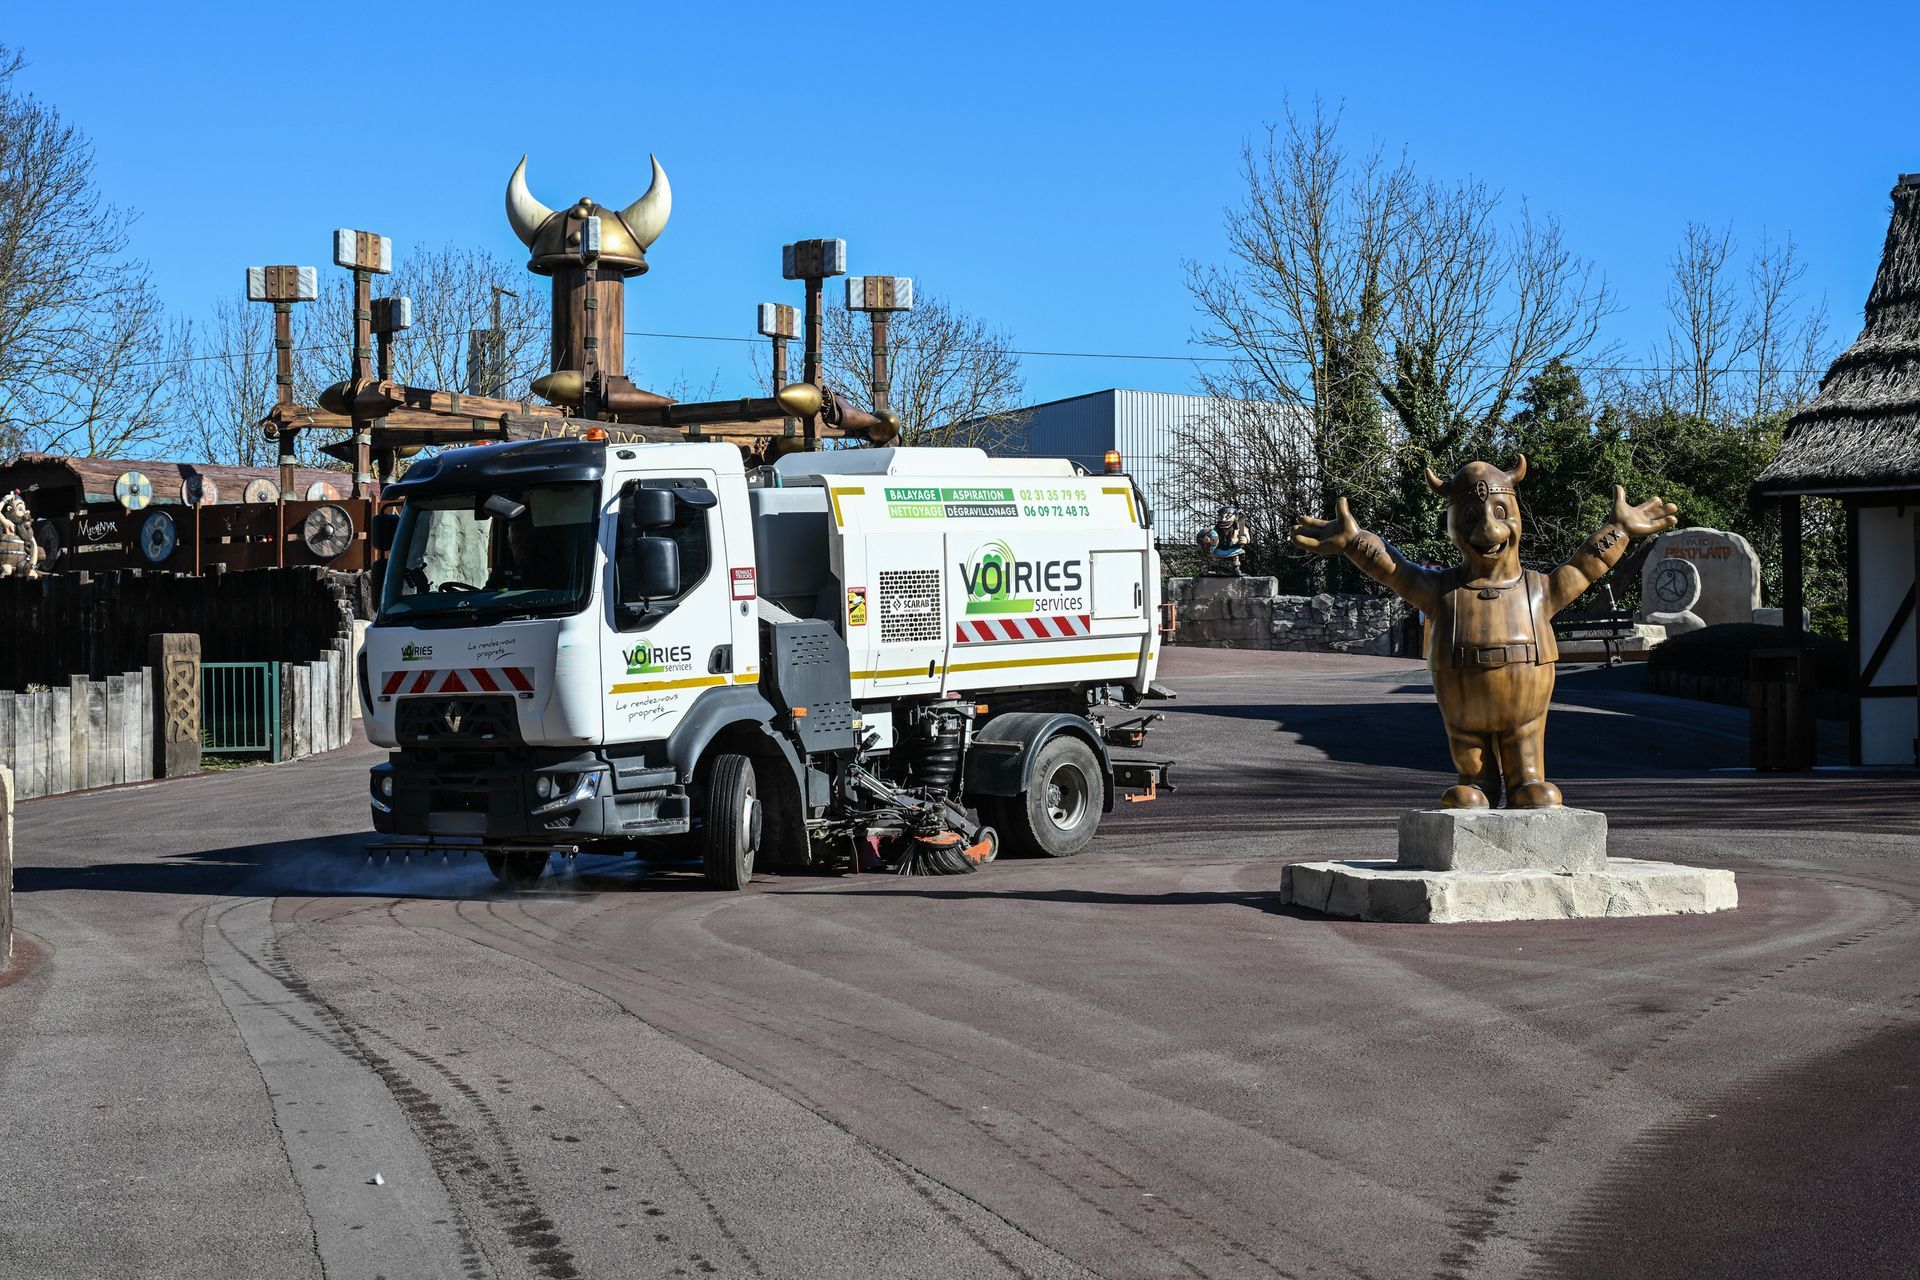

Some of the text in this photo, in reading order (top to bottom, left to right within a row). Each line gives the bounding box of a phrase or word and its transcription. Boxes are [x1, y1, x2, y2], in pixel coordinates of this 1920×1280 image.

[890, 489, 936, 501] BALAYAGE
[952, 489, 1005, 501] ASPIRATION
[1020, 489, 1087, 501] 02 31 35 79 95
[890, 505, 943, 517] NETTOYAGE
[947, 504, 1017, 517] DÉGRAVILLONAGE
[1024, 504, 1090, 517] 06 09 72 48 73
[959, 560, 1083, 595] VOIRIES
[903, 599, 930, 609] SCARAB
[1035, 593, 1083, 612] services
[401, 645, 433, 657] VOIRIES
[467, 638, 517, 651] Le rendez-vous
[622, 645, 692, 666] VOIRIES
[664, 662, 693, 673] services
[615, 693, 679, 711] Le rendez-vous
[628, 704, 665, 723] propreté
